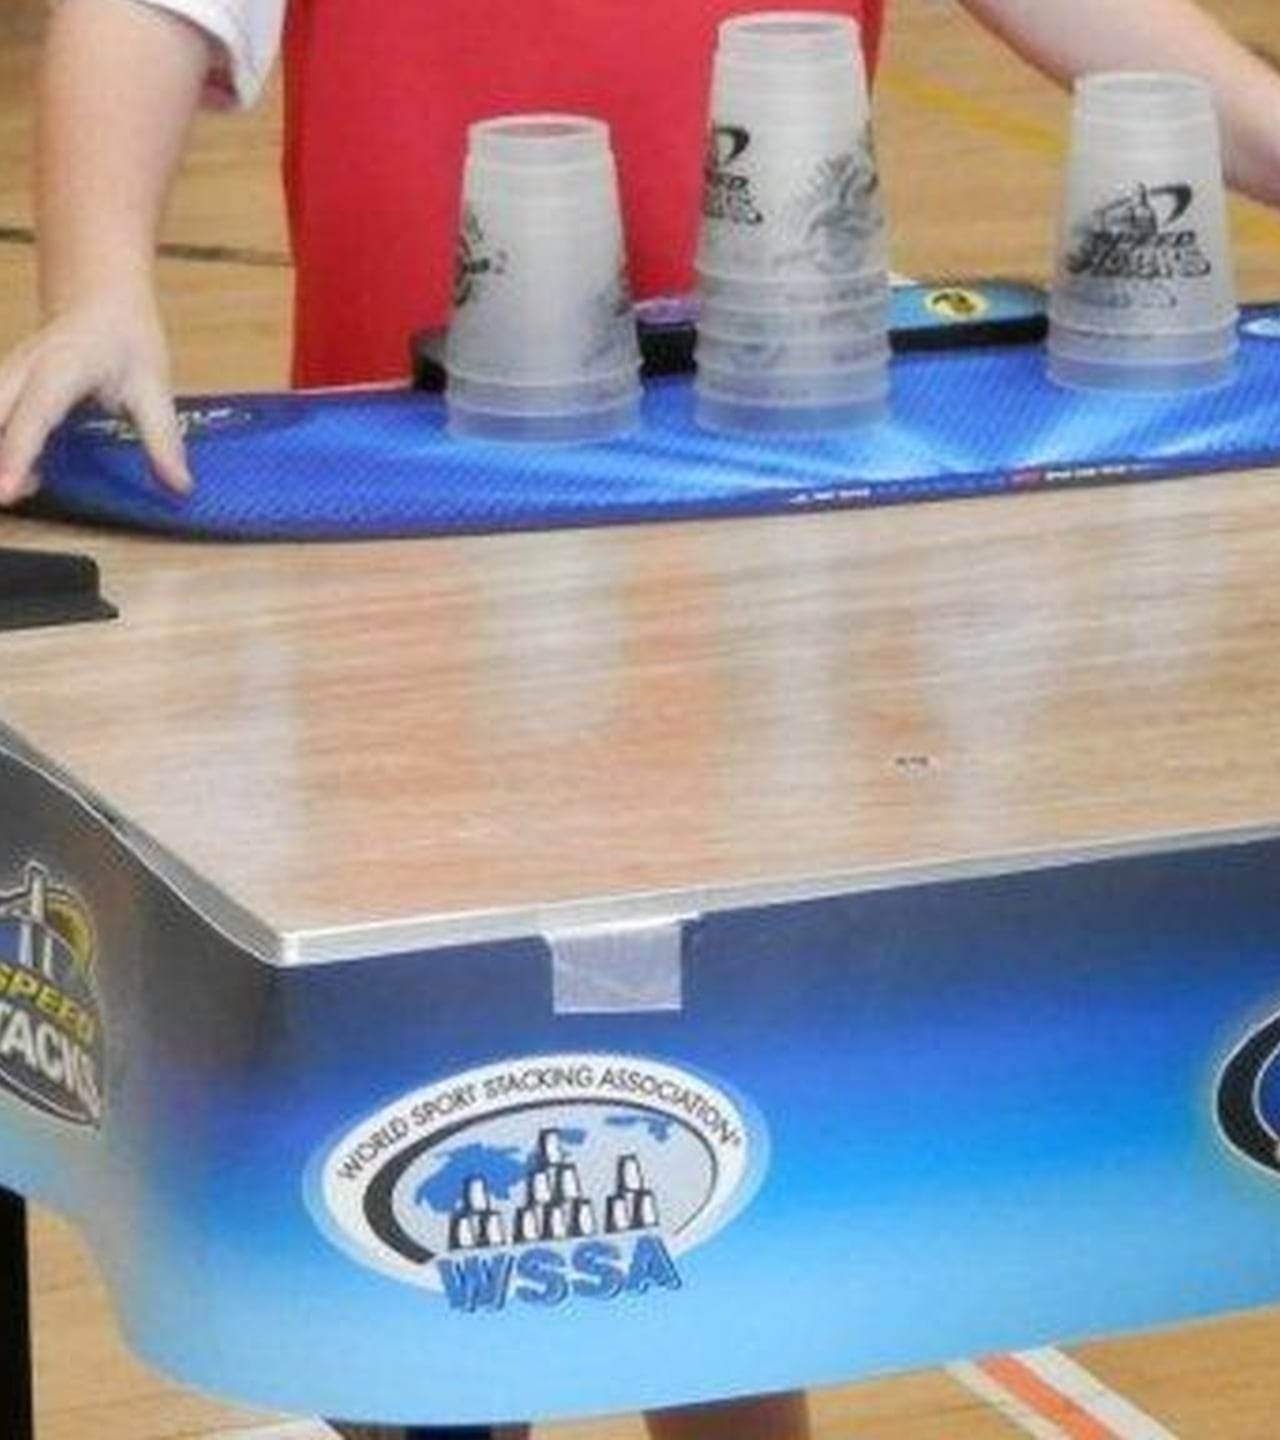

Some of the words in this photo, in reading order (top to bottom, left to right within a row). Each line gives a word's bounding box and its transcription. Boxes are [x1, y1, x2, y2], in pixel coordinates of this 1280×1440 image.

[336, 1110, 411, 1182] WORLD
[413, 1082, 477, 1127] SPORT
[481, 1064, 594, 1100] STACKING
[600, 1065, 733, 1148] ASSOCIATION
[436, 1234, 684, 1313] WSSA
